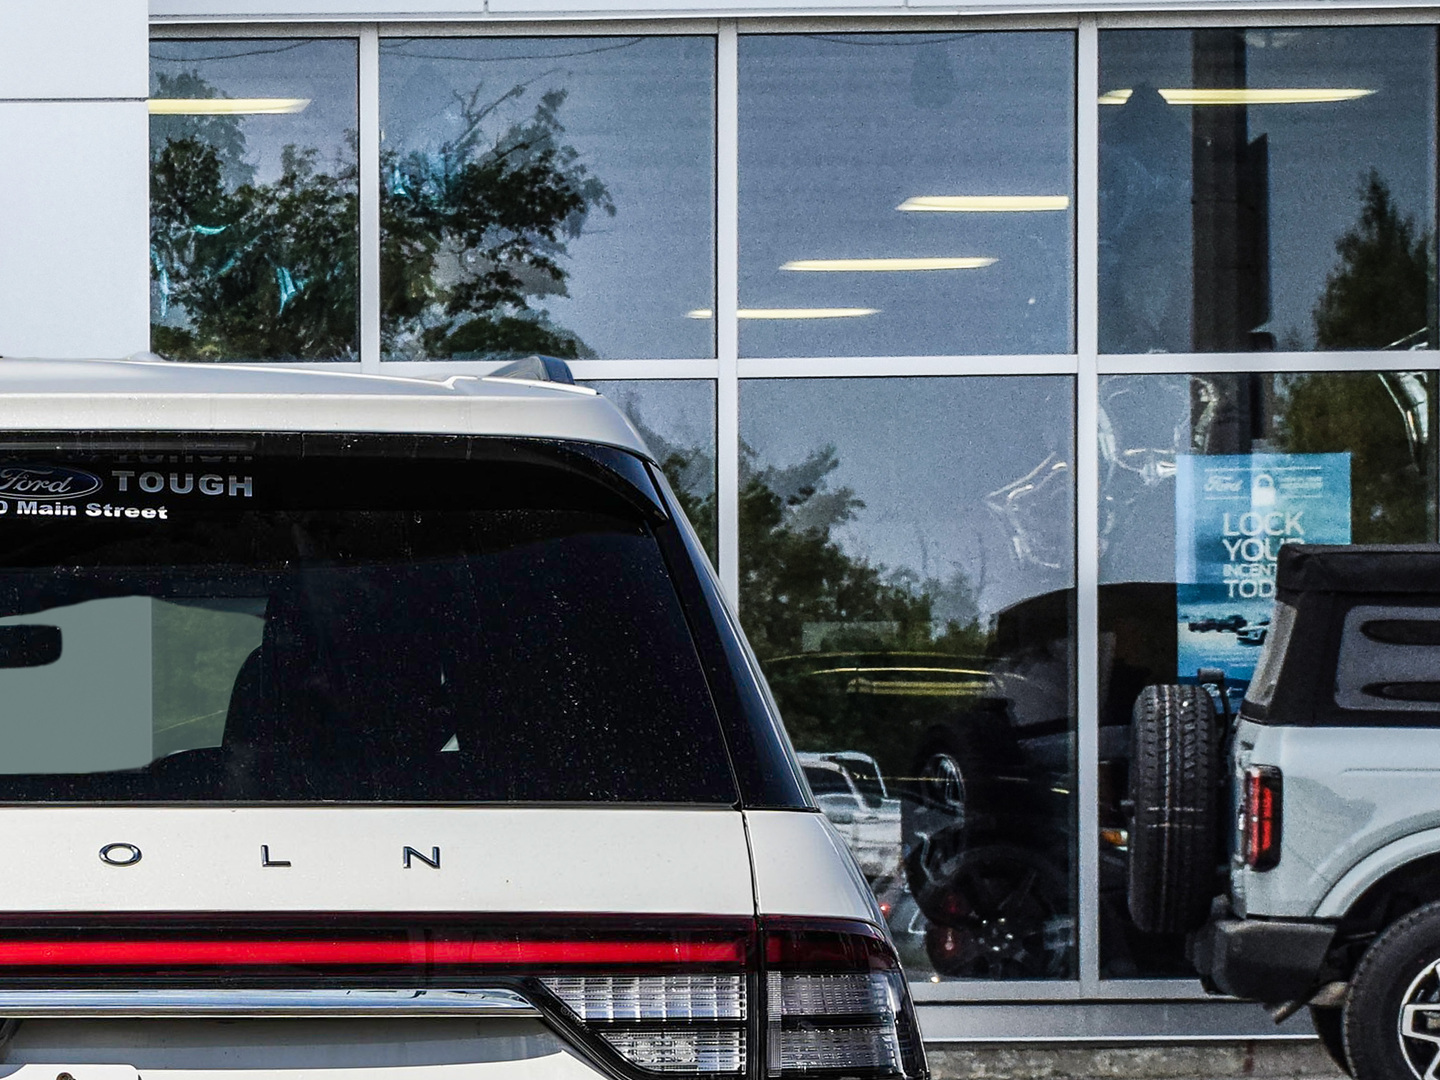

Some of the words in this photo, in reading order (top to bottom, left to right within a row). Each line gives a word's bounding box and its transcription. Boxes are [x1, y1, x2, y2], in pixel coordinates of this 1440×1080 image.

[111, 470, 253, 498] TOUGH
[16, 500, 78, 517] Main
[85, 502, 168, 520] Street
[1222, 511, 1305, 536] LOCK
[1222, 538, 1305, 562] YOU
[1222, 580, 1277, 598] TOD
